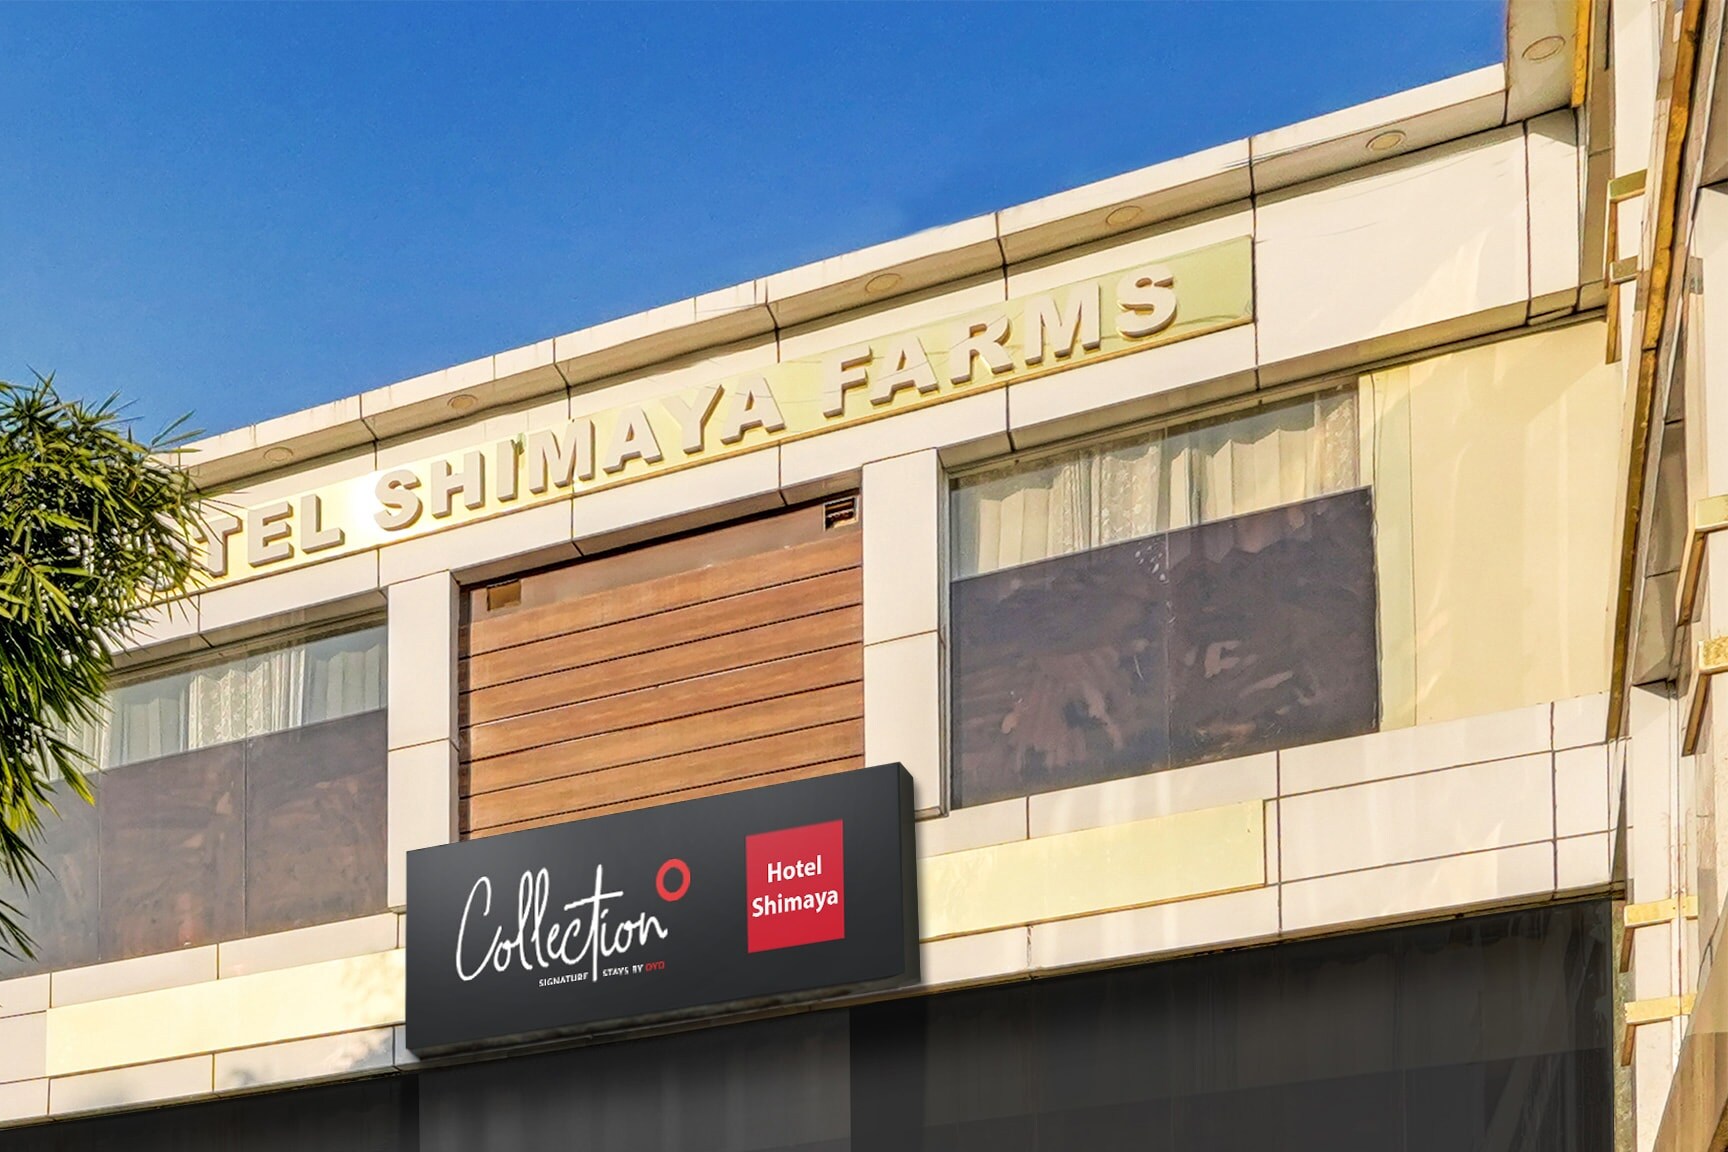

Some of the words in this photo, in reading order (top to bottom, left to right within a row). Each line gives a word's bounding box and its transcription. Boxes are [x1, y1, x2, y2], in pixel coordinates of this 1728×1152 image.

[148, 494, 346, 591] TEL
[373, 373, 787, 531] SHIMAYA
[822, 264, 1178, 420] FARMS
[766, 855, 823, 885] Hotel
[751, 886, 840, 918] Shimaya
[455, 863, 669, 983] Collection
[602, 966, 630, 977] STAYS
[632, 964, 644, 974] BY
